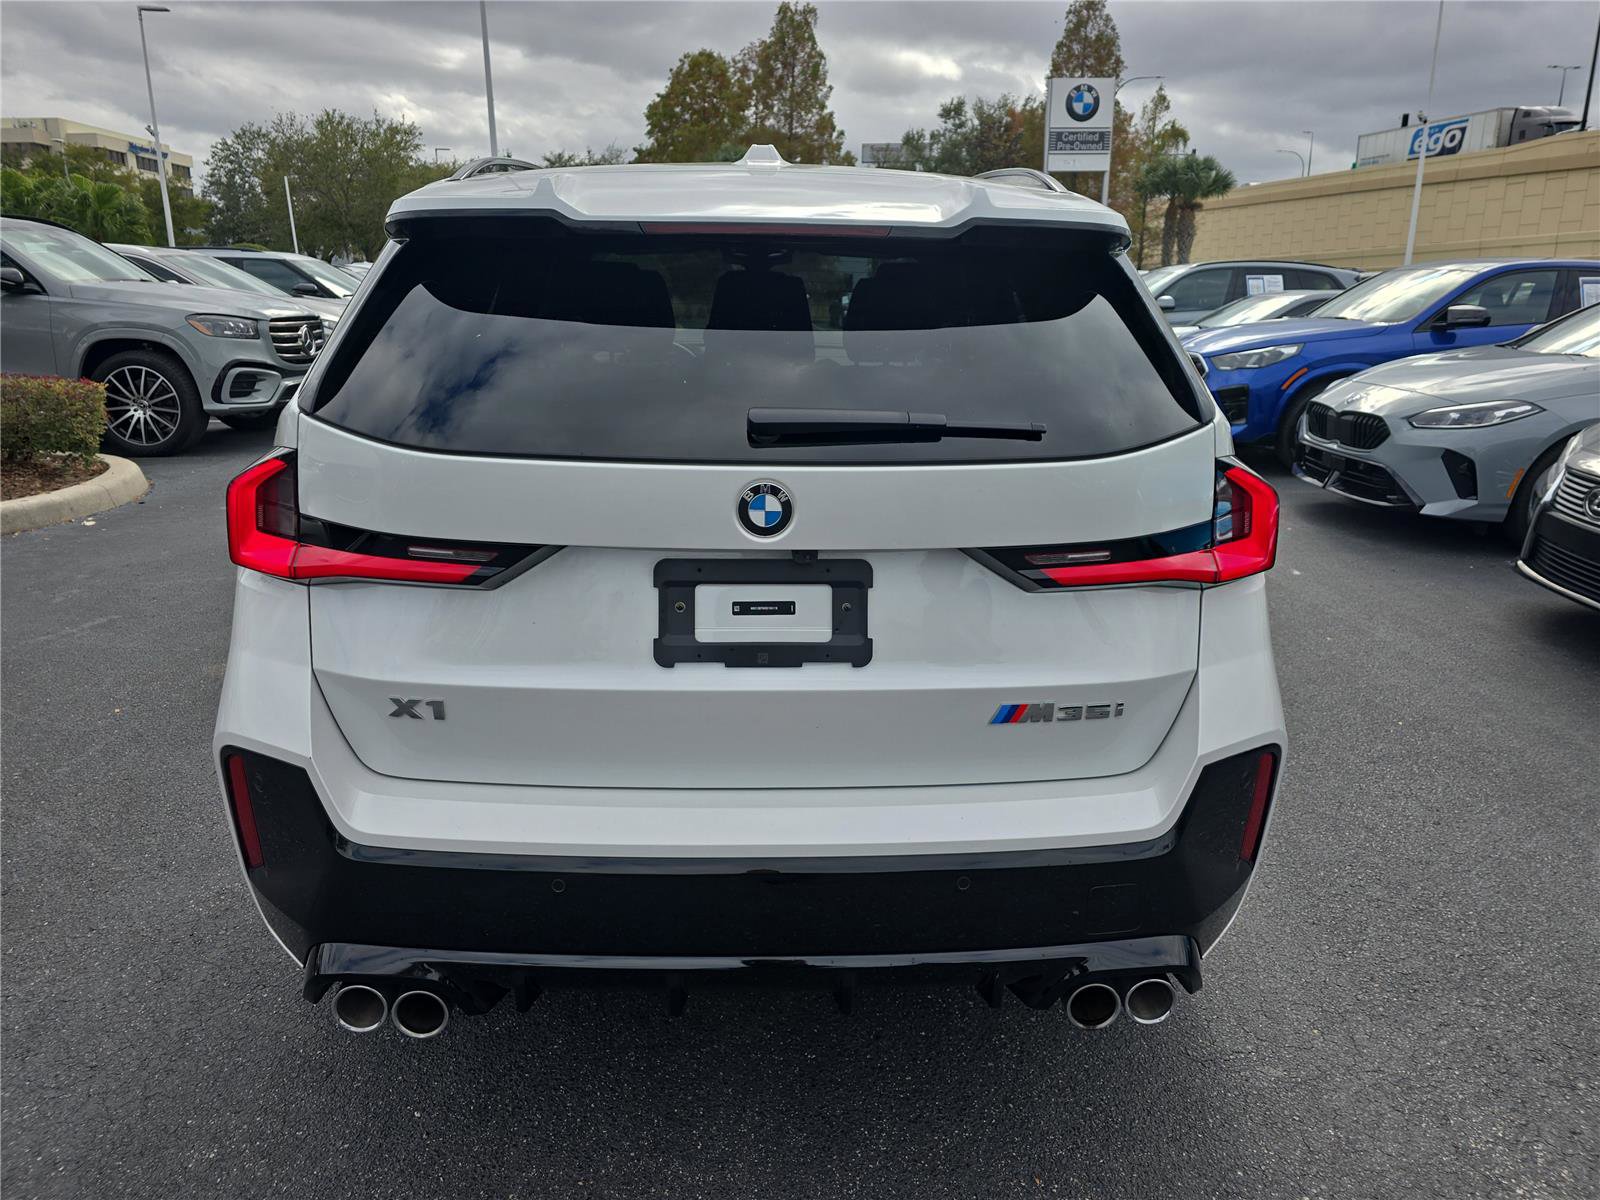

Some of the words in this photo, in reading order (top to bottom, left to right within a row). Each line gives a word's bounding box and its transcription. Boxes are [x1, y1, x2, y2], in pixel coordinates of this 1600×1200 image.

[1062, 132, 1100, 141] Certified
[1056, 141, 1103, 150] Pre-Owned
[742, 483, 789, 503] BMW
[388, 697, 446, 721] X1
